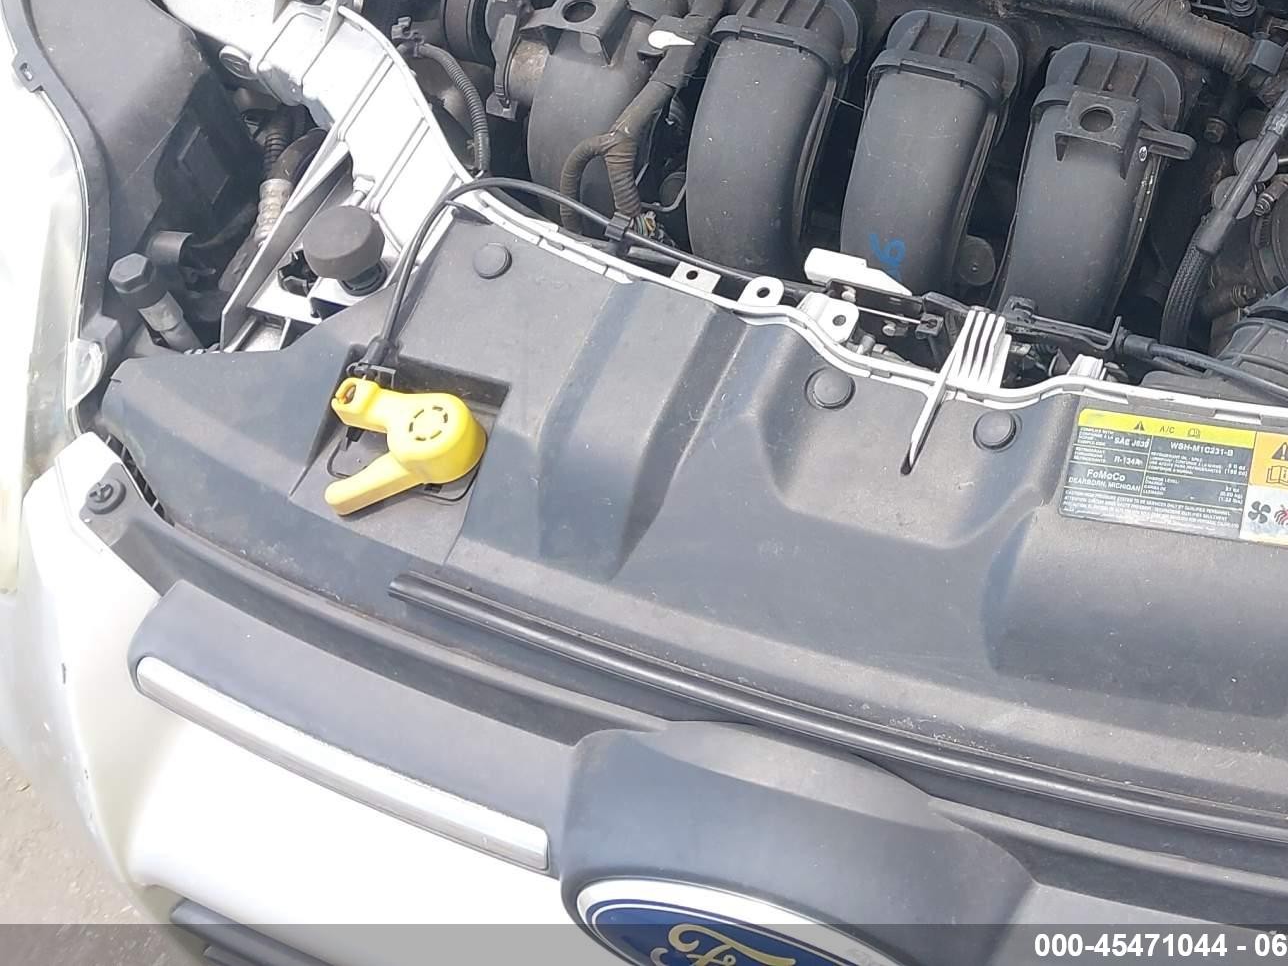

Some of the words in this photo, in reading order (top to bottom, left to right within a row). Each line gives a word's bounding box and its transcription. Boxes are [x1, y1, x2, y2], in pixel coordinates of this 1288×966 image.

[1159, 425, 1175, 435] A/C
[1114, 436, 1130, 447] SAE
[1086, 468, 1126, 483] FoMoCo
